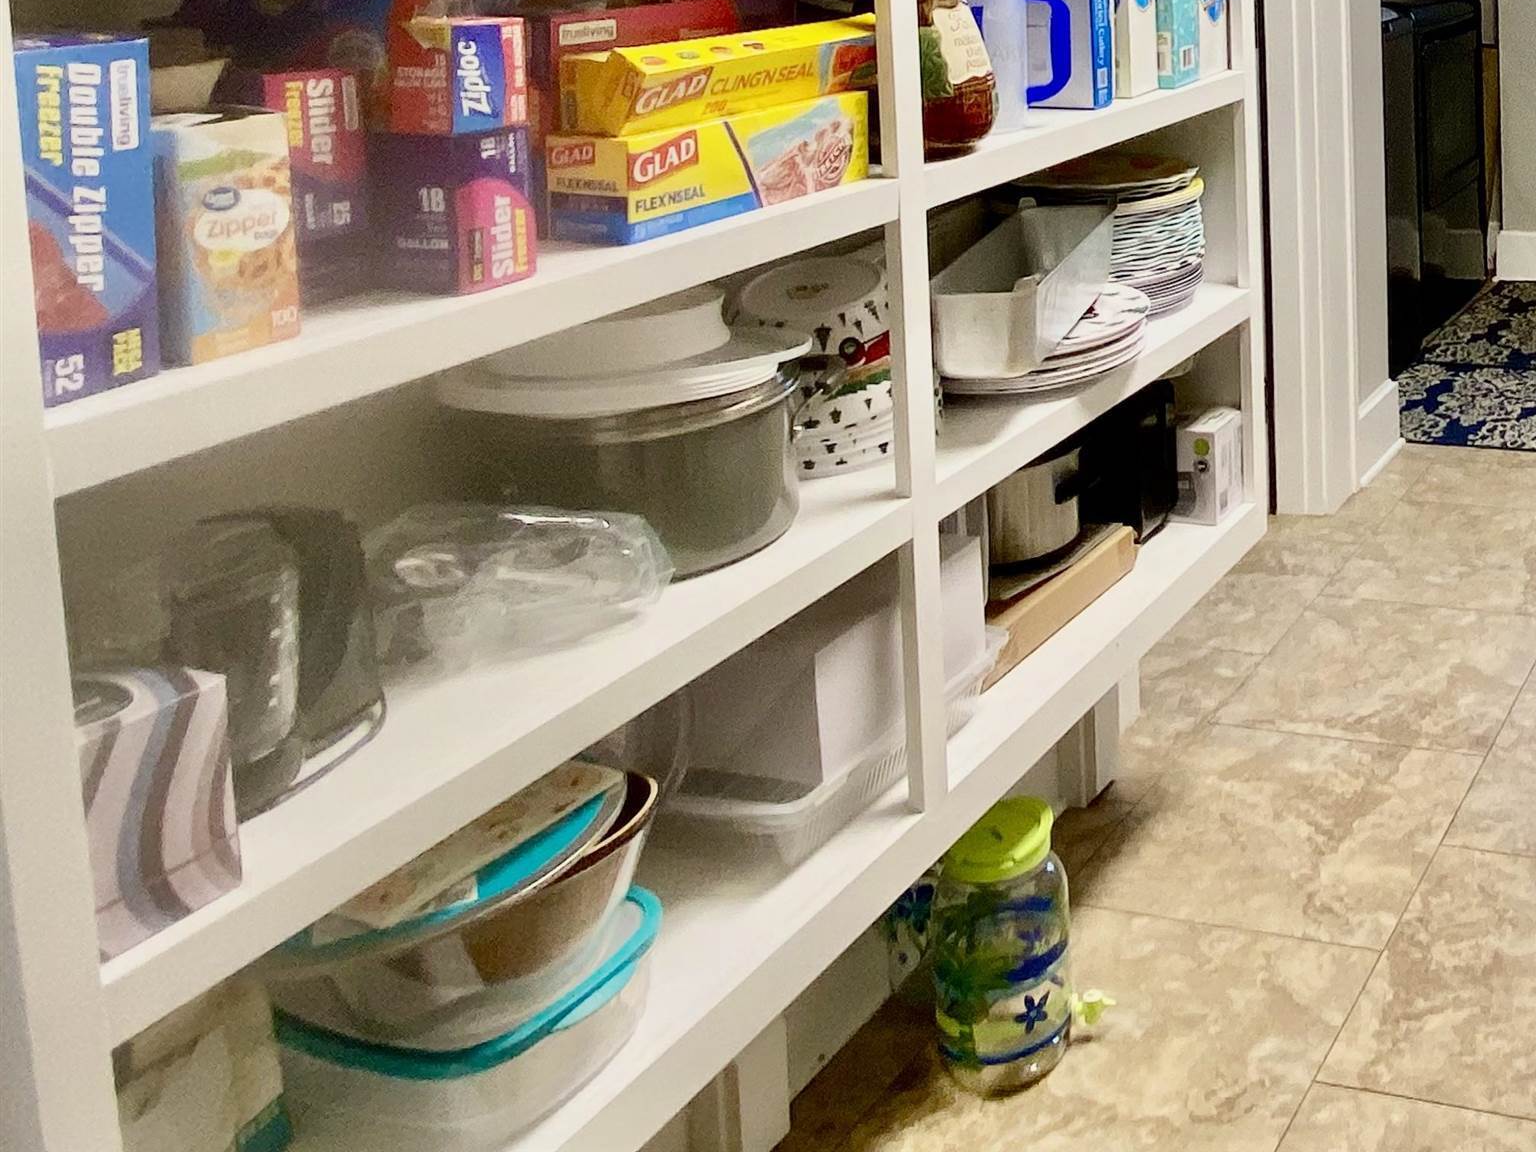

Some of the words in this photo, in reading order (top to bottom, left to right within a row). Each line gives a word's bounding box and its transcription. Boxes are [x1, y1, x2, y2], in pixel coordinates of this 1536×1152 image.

[1097, 27, 1109, 65] Cutlery
[458, 40, 492, 117] Ziploc
[635, 71, 710, 115] GLAD
[36, 64, 64, 166] Freezer
[67, 63, 102, 177] Double
[307, 78, 336, 165] Slider
[551, 145, 594, 168] GLAD
[632, 136, 697, 184] GLAD
[418, 186, 445, 213] 18
[67, 186, 107, 292] Zipper
[207, 210, 279, 238] Zipper
[491, 196, 515, 280] Slider
[55, 352, 85, 396] 52
